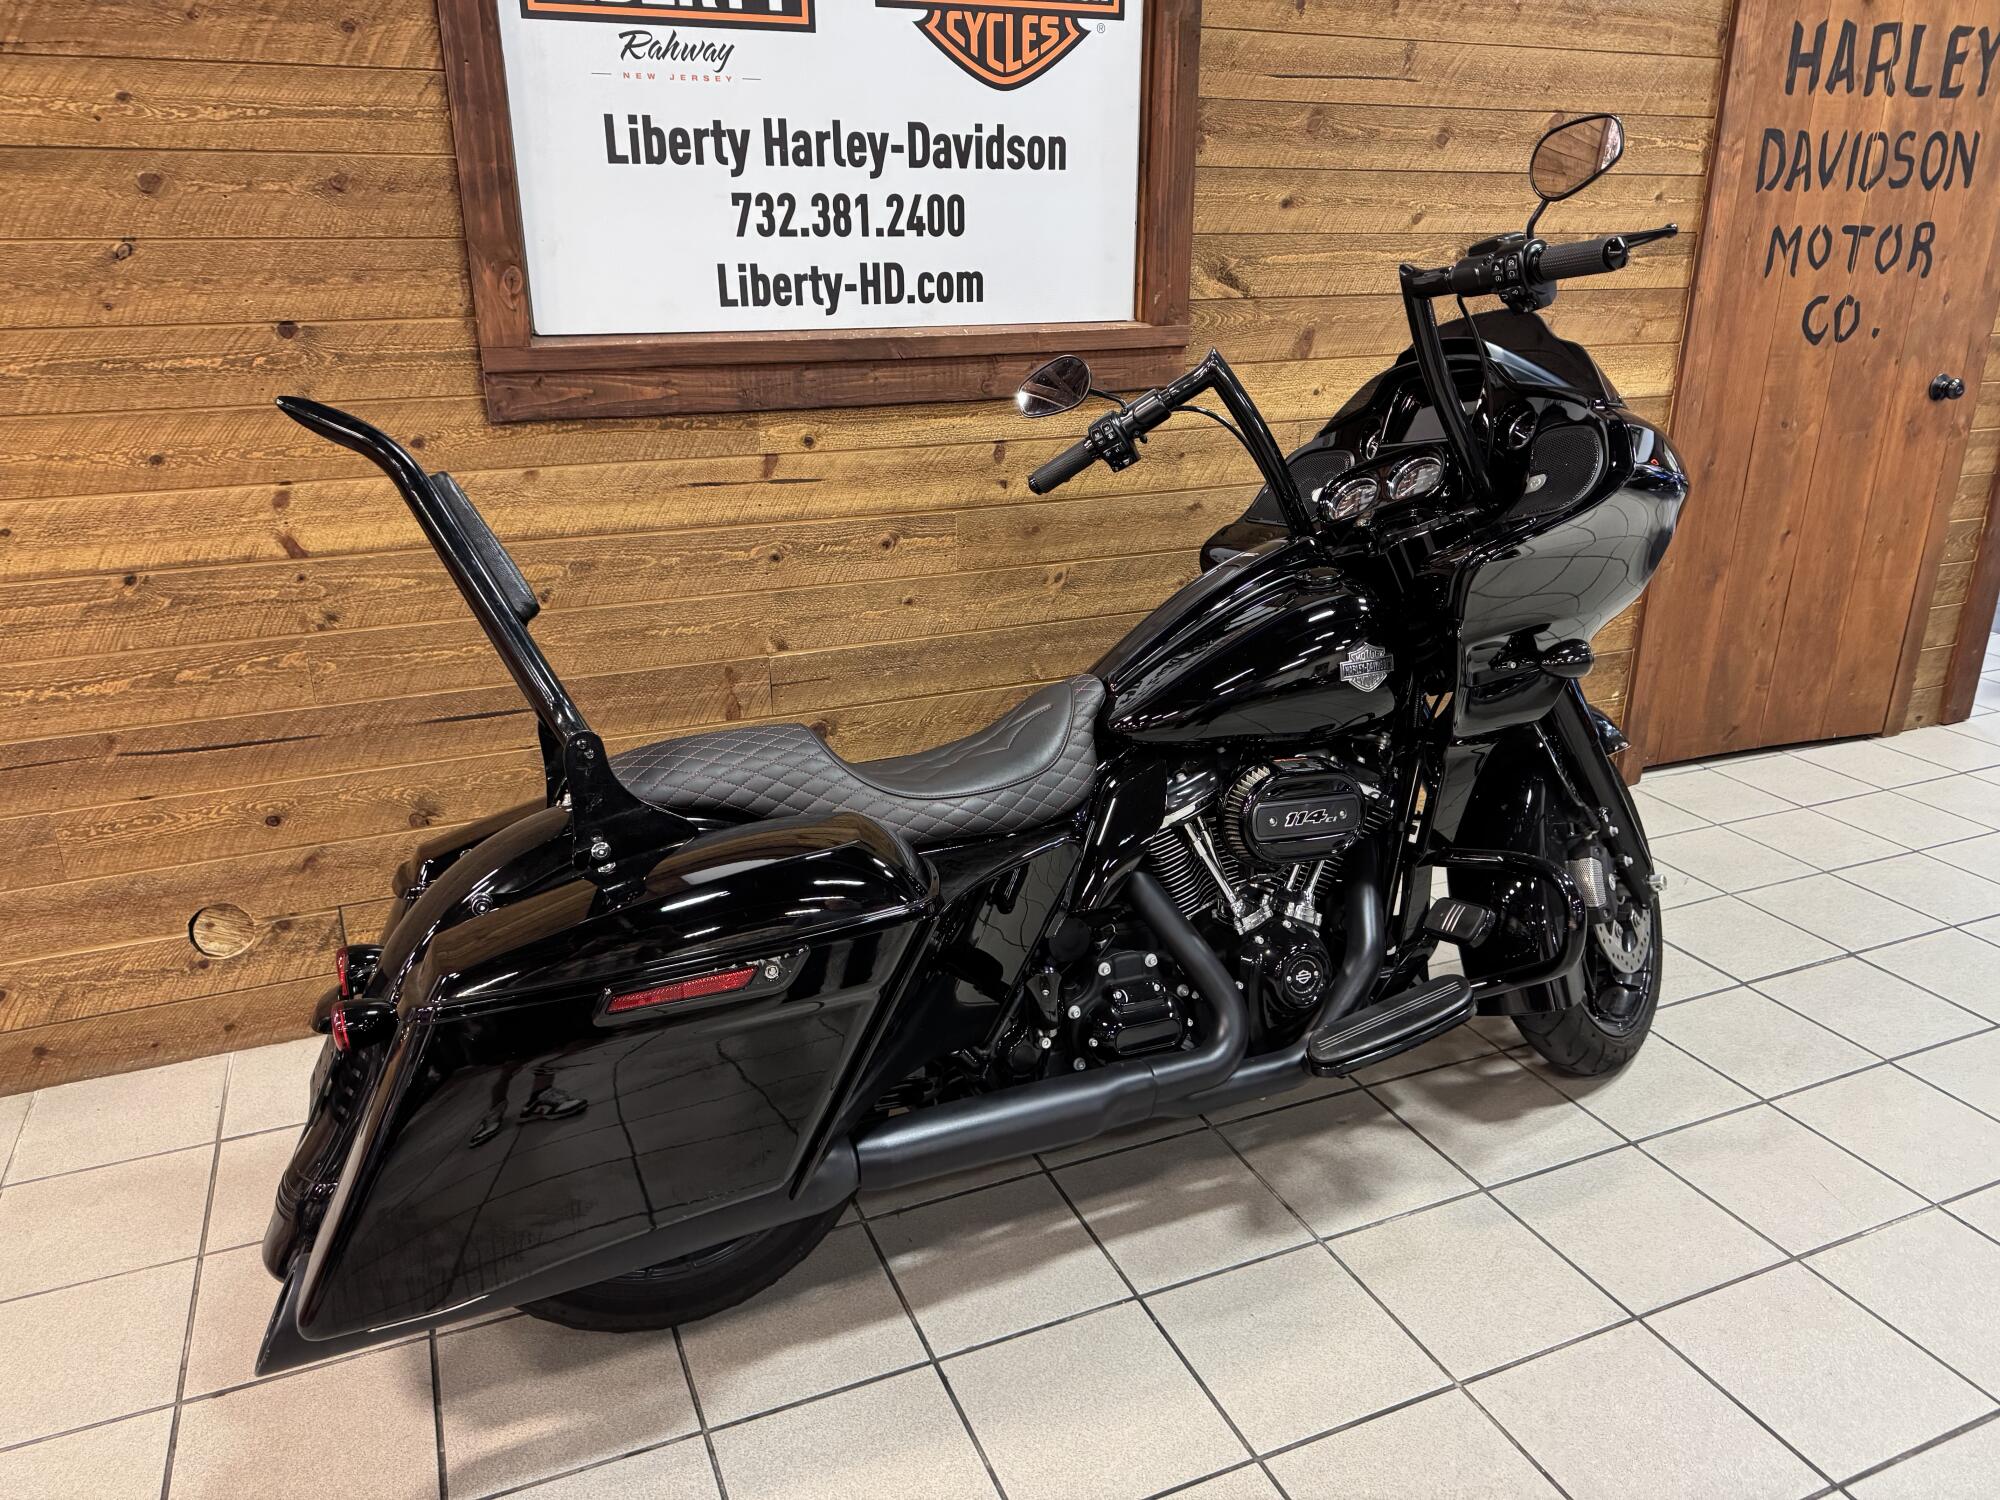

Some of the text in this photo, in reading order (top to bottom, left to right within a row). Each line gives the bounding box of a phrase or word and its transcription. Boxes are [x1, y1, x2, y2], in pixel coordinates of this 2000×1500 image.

[618, 29, 735, 73] Rahway
[947, 10, 1060, 73] CYCLES
[1785, 20, 2000, 98] HARLEY
[622, 71, 734, 83] NEW JERSEY
[603, 114, 1067, 180] Liberty Harley-Davidson
[1755, 128, 1981, 193] DAVIDSON
[731, 192, 966, 238] 732.381.2400
[1764, 221, 1936, 279] MOTOR
[716, 262, 984, 316] Liberty-HD.com
[1801, 294, 1880, 346] CO.
